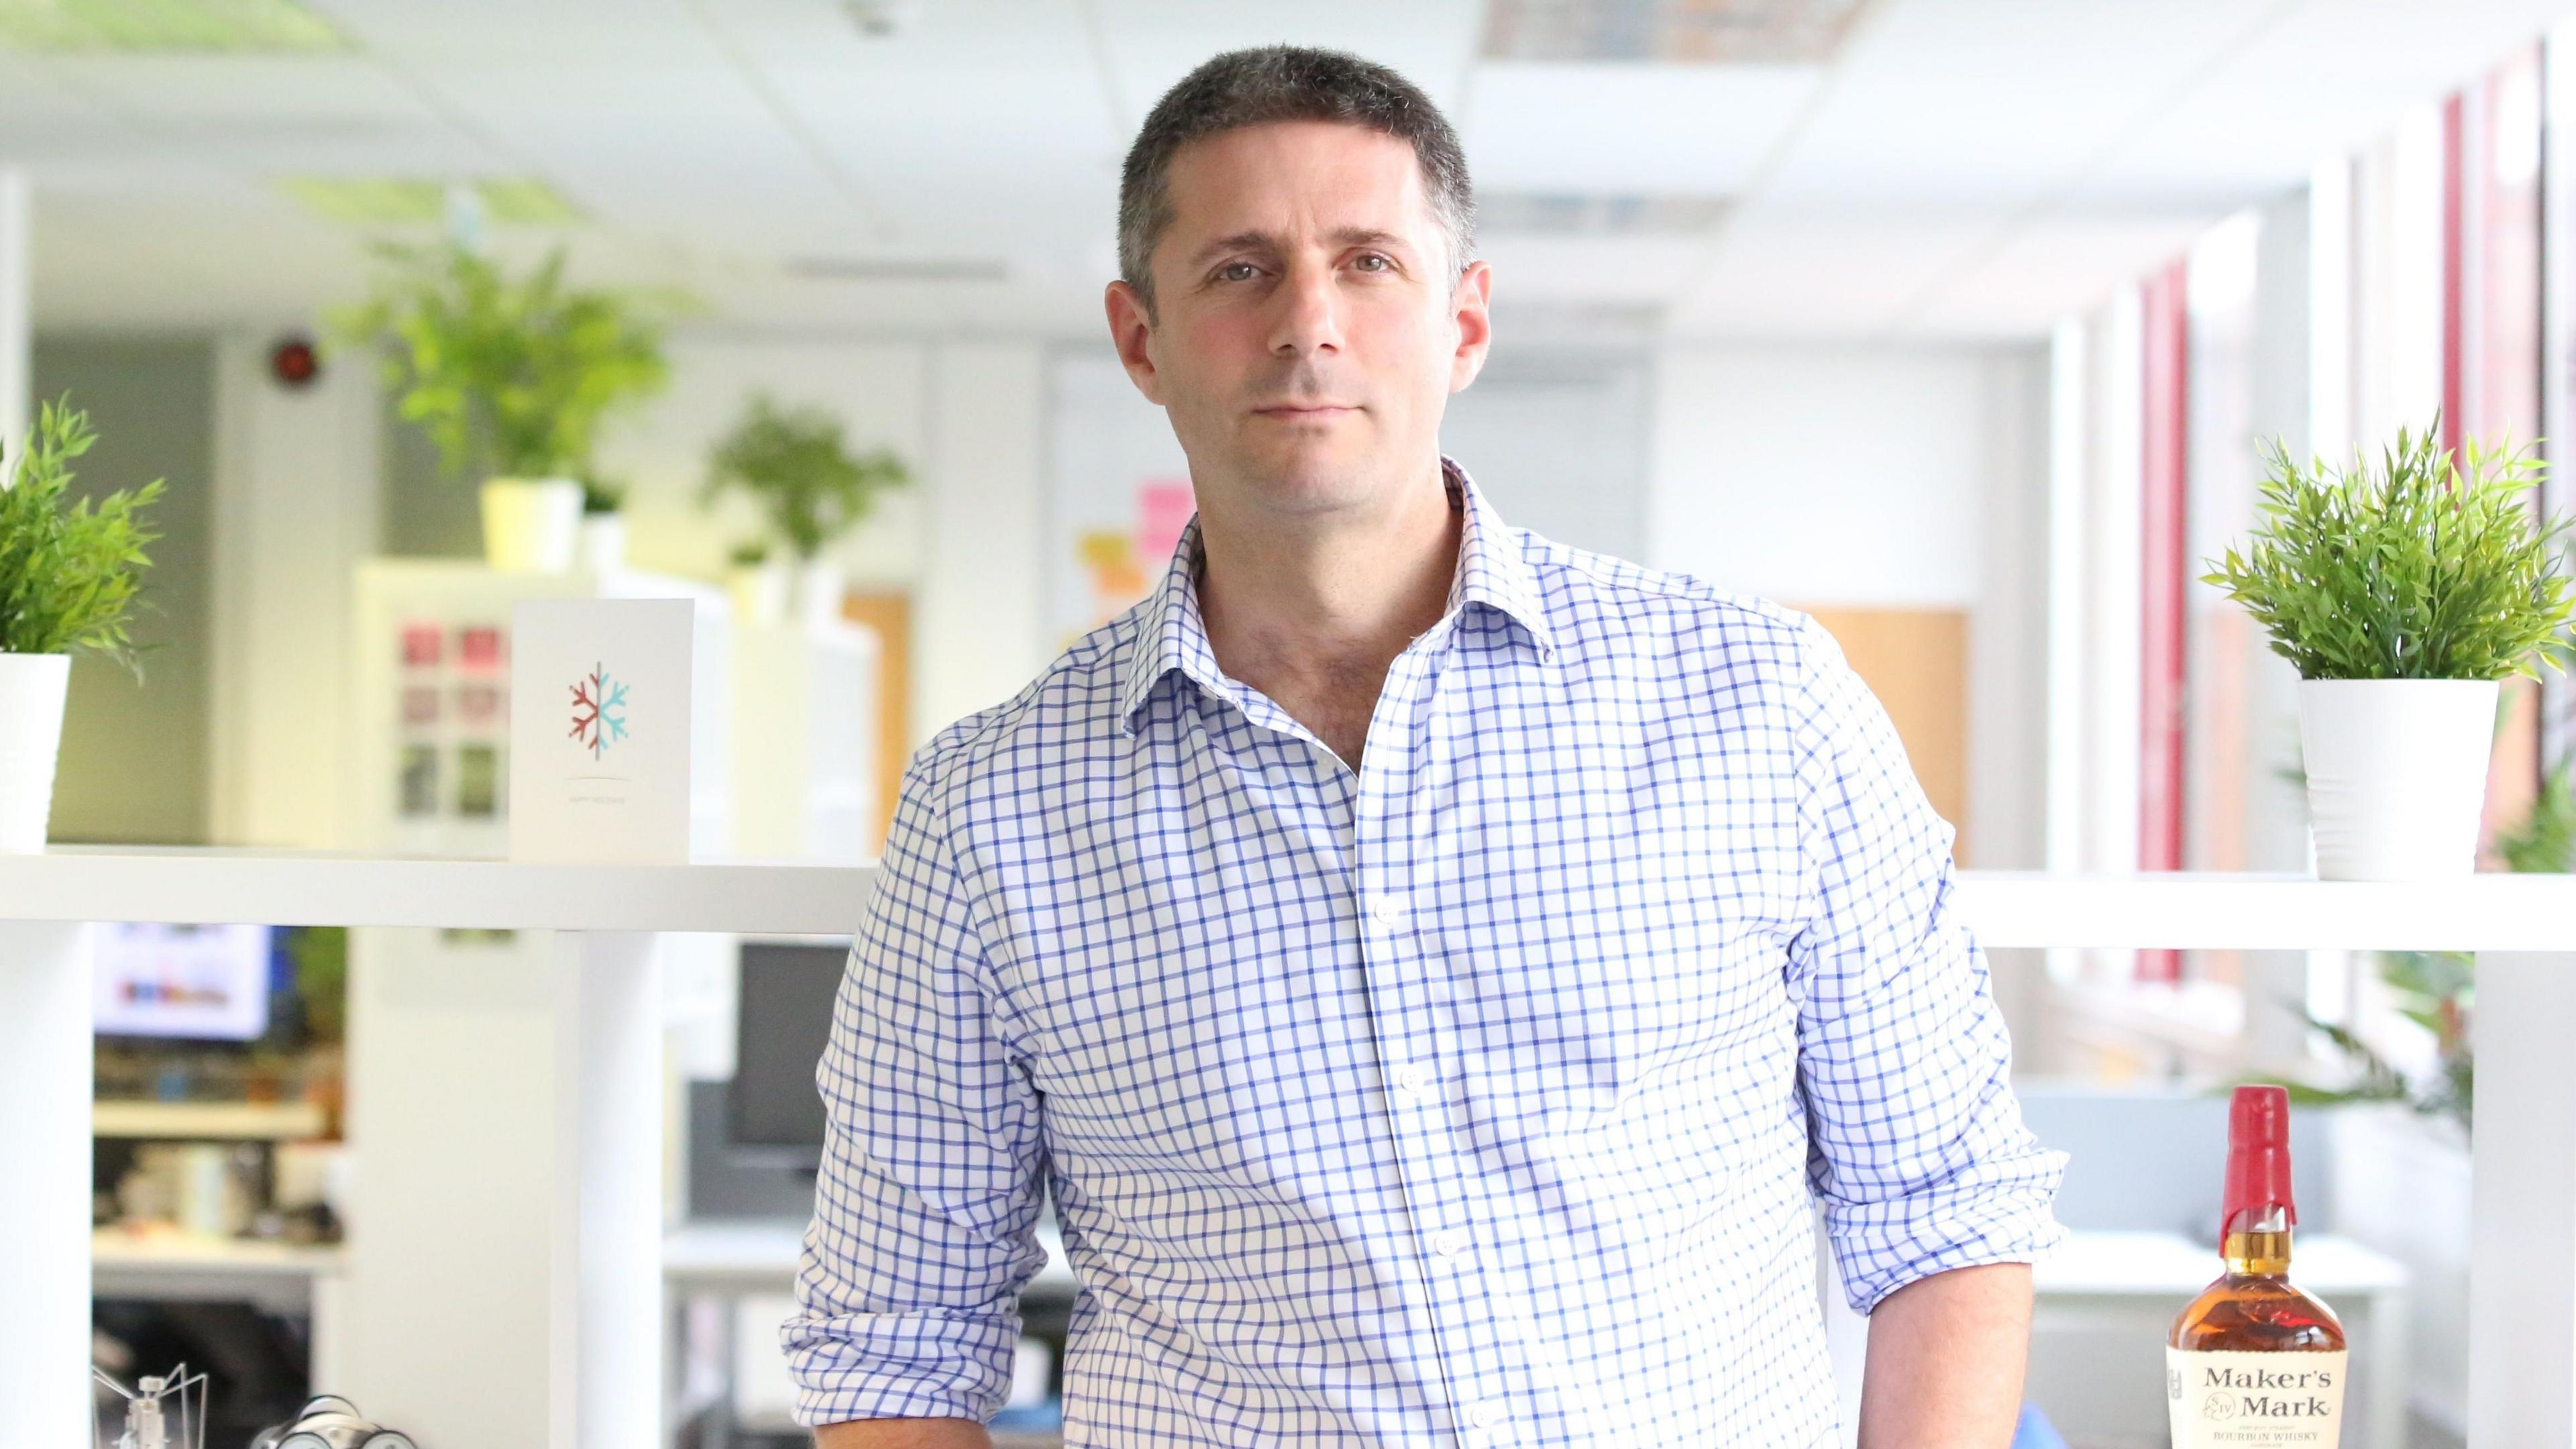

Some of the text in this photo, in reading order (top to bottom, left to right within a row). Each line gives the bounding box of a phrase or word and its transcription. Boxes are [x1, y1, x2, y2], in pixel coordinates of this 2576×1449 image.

[2203, 1367, 2331, 1389] Maker's
[2239, 1396, 2331, 1417] Mark
[2213, 1432, 2319, 1442] BOURBON WHISKY
